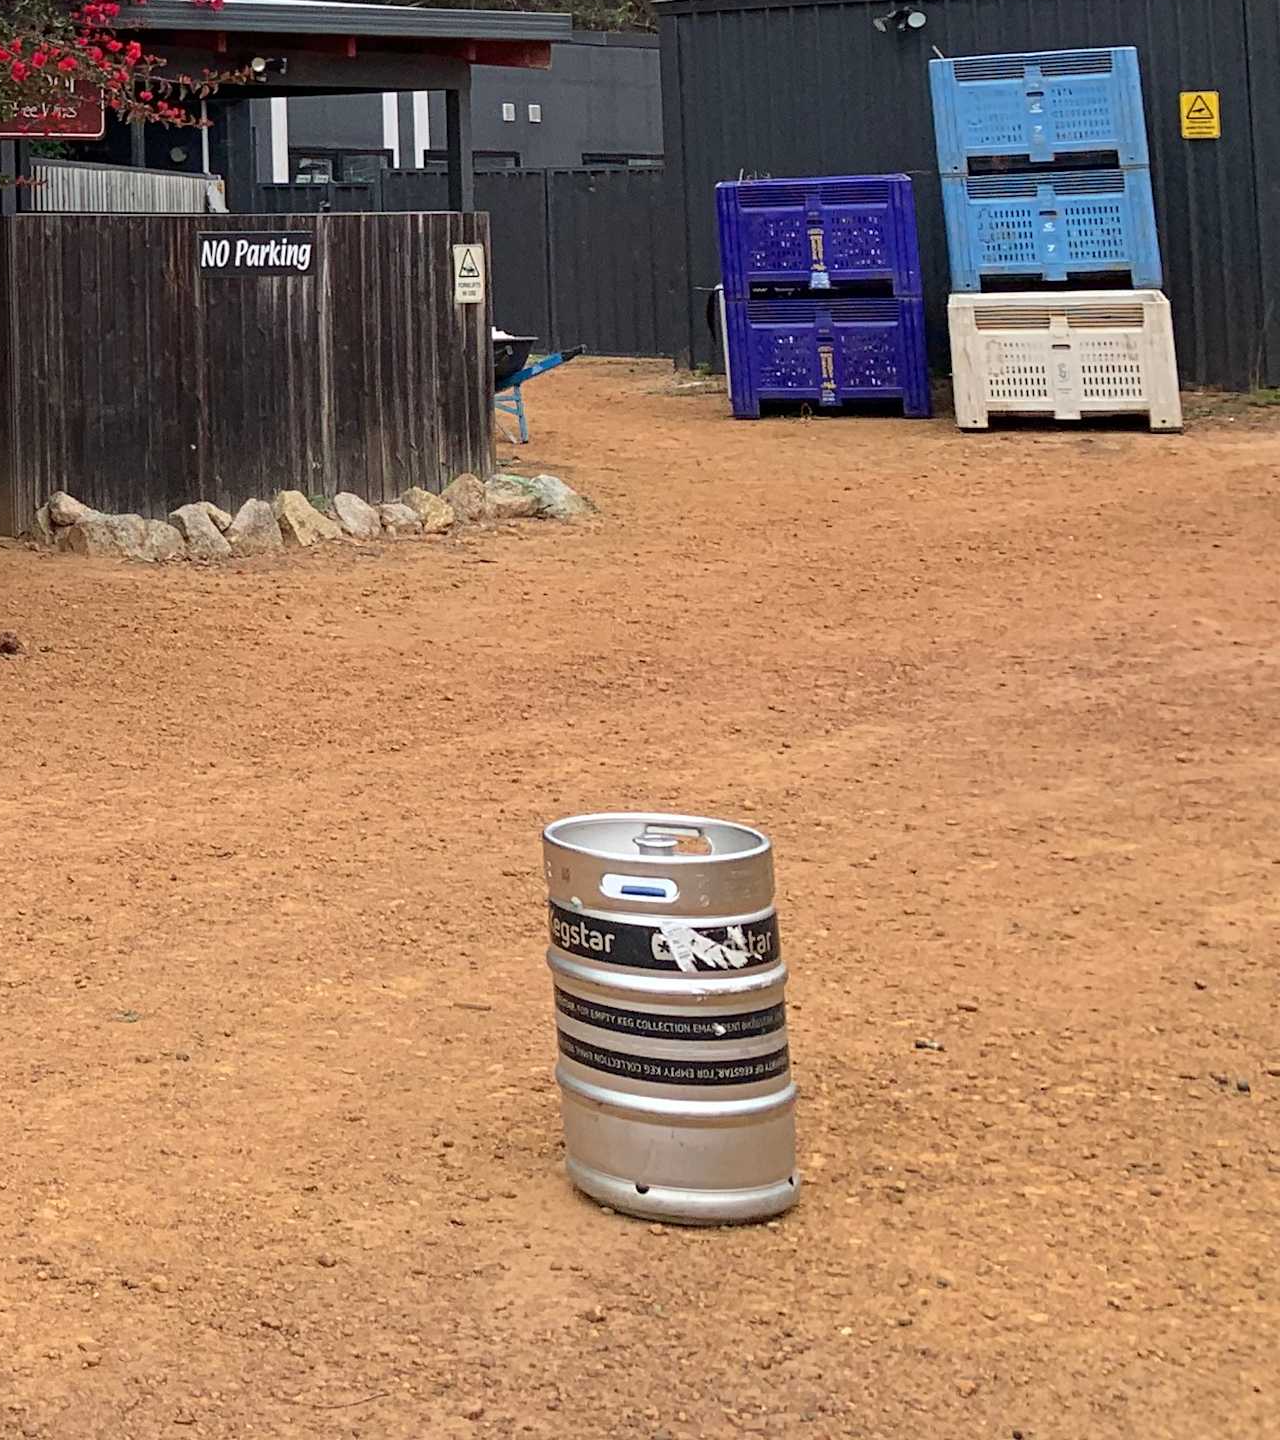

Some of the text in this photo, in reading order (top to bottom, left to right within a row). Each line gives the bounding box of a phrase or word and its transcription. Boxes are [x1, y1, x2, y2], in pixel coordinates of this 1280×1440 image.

[201, 237, 312, 272] NO Parking
[550, 910, 615, 953] egstar
[617, 1016, 634, 1028] KEG
[636, 1019, 691, 1033] COLLECTION
[693, 1023, 718, 1033] EMA
[594, 1053, 641, 1073] COLLECTION
[643, 1063, 662, 1076] KEG
[663, 1067, 695, 1078] EMPTY
[697, 1069, 715, 1078] FOR
